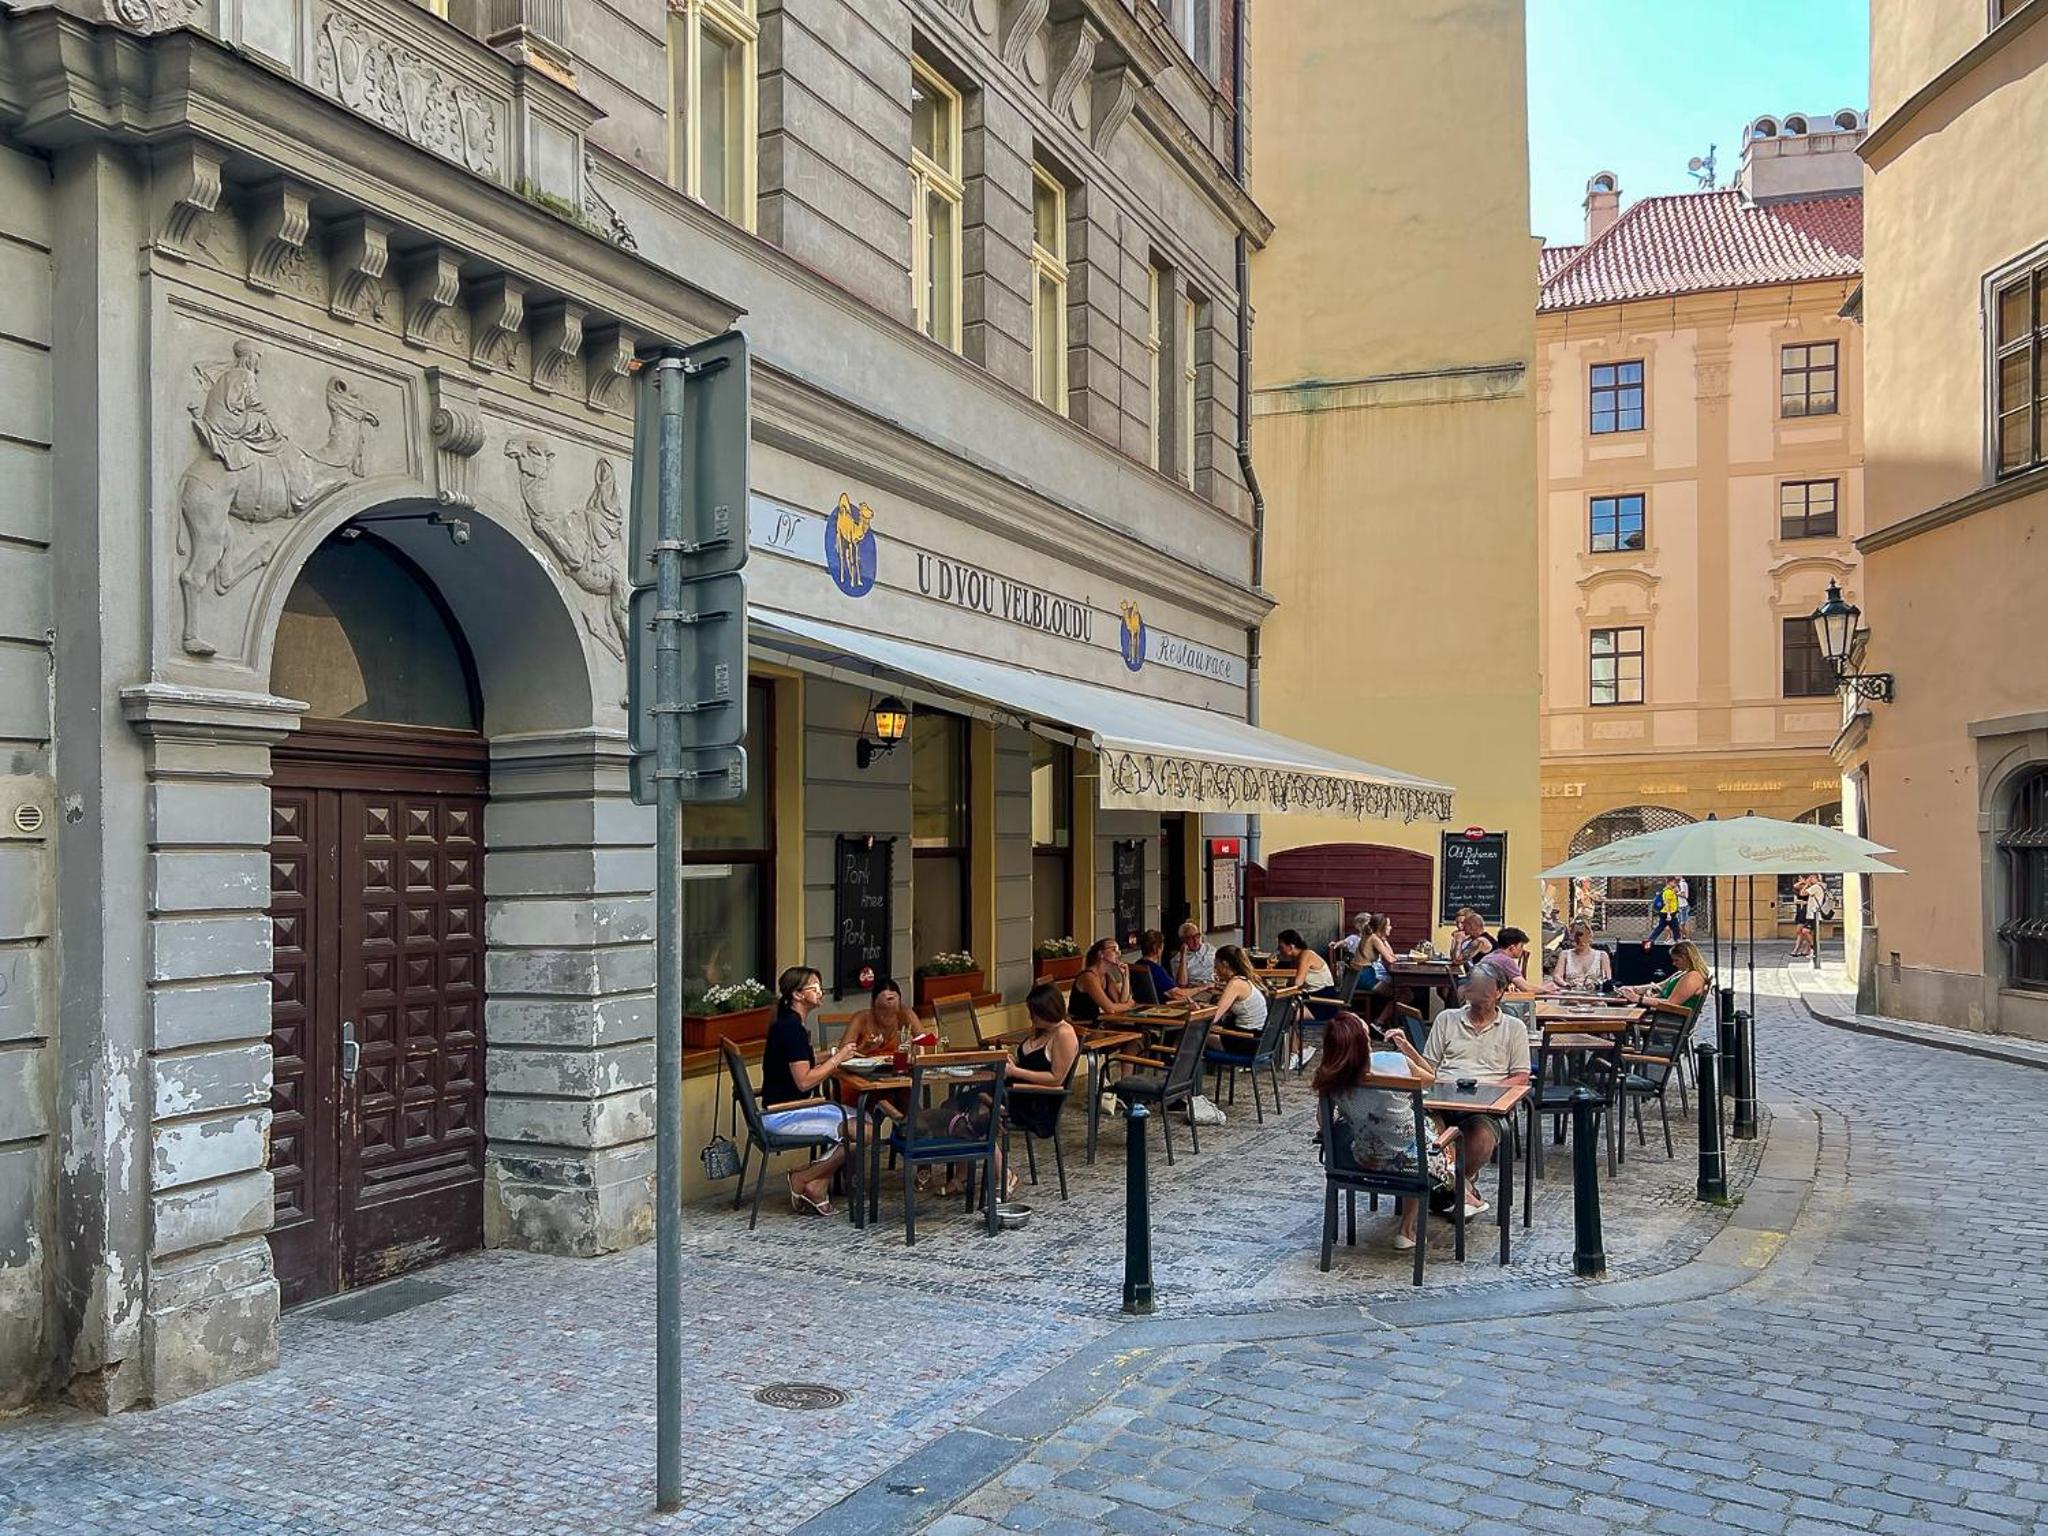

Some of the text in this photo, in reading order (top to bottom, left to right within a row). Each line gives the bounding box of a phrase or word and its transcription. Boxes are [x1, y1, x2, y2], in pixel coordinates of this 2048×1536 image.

[916, 552, 1093, 642] U DVOU VELBLOUDŮ
[1156, 635, 1232, 679] Restaurace
[845, 854, 870, 884] Pork
[842, 917, 866, 946] Pork
